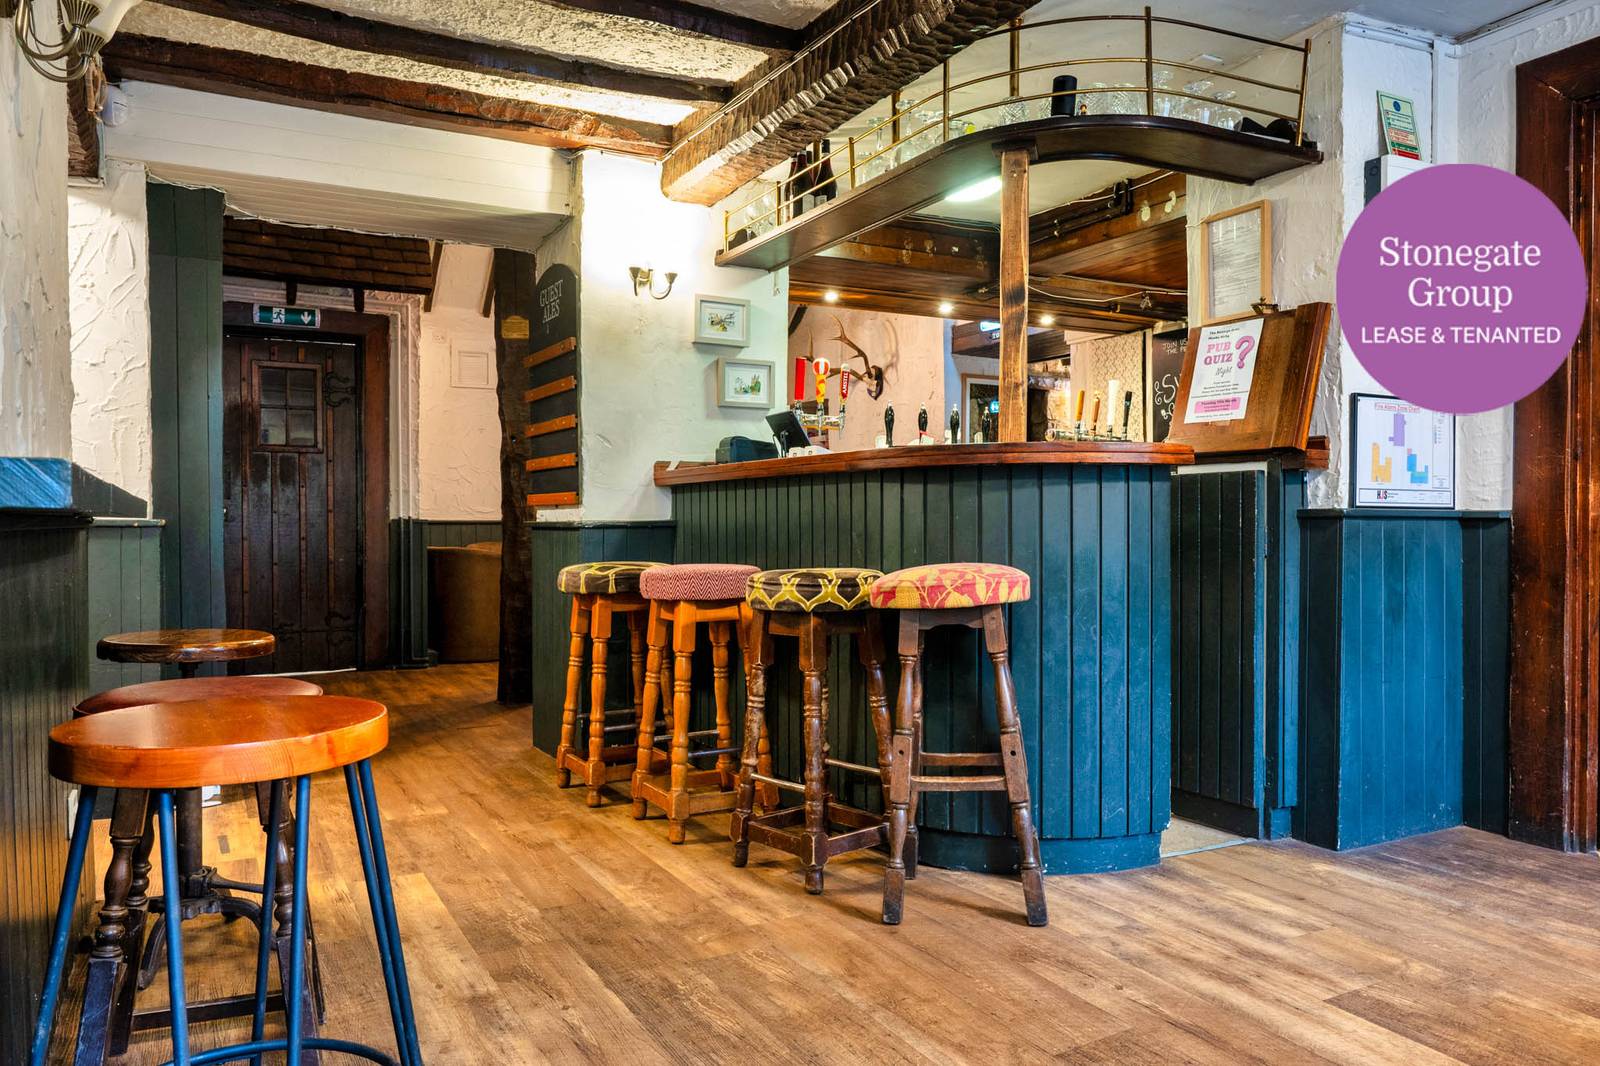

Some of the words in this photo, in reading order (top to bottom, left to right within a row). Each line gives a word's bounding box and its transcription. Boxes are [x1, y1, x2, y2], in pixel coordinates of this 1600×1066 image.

[540, 279, 563, 307] GUEST
[544, 299, 560, 321] ALES
[1163, 341, 1178, 351] JOIN
[1207, 341, 1231, 353] PUB
[1204, 352, 1233, 365] QUIZ
